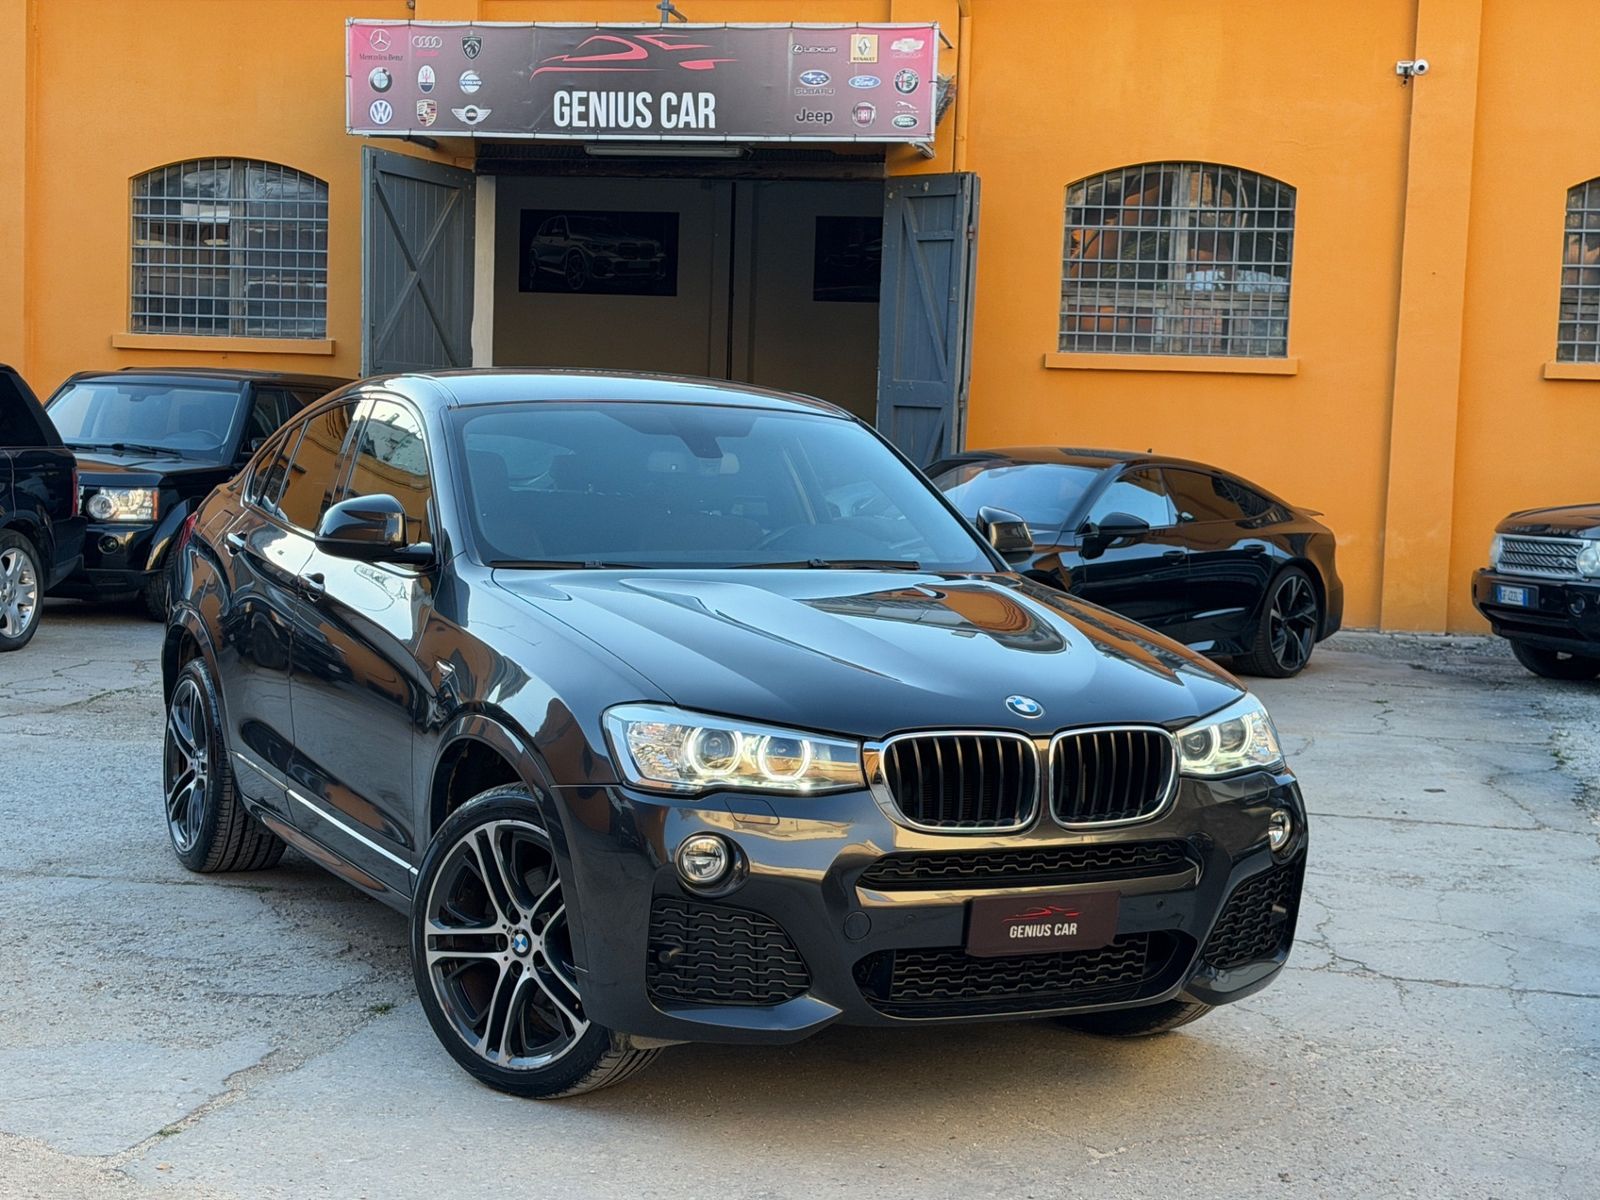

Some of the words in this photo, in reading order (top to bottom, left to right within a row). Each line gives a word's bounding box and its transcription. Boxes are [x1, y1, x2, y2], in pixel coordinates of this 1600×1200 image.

[795, 88, 834, 96] SUBARU
[553, 90, 653, 128] GENIUS
[660, 92, 716, 129] CAR
[796, 109, 833, 124] Jeep
[1009, 924, 1051, 938] GENIUS
[1054, 923, 1077, 935] CAR
